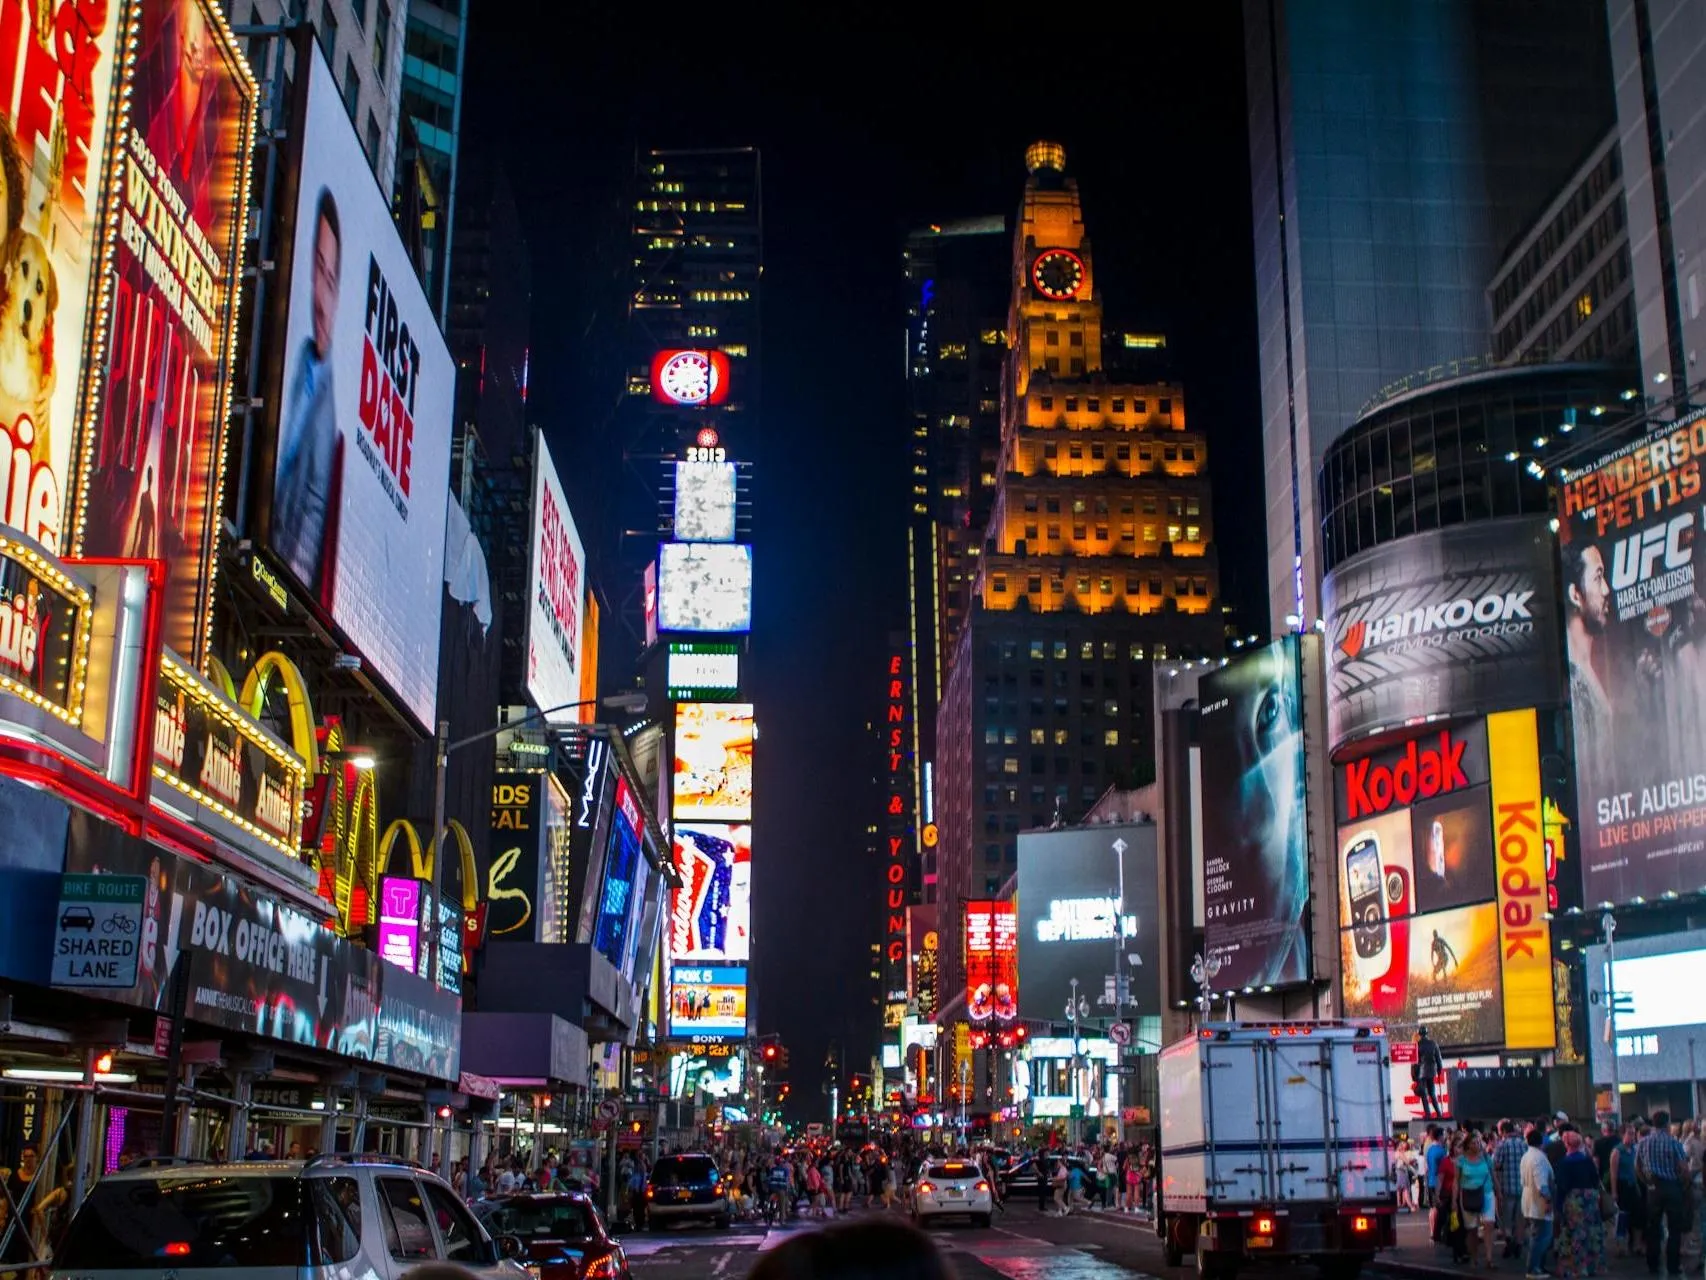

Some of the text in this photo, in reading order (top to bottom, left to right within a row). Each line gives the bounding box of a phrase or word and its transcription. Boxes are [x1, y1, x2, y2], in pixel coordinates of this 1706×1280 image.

[157, 165, 187, 224] TONY
[127, 154, 219, 323] WINNER!
[121, 207, 214, 360] BEST MUSICAL REVIVAL
[364, 250, 421, 419] FIRST
[359, 333, 414, 499] DATE
[686, 447, 726, 462] 2013
[1563, 464, 1593, 484] WORLD
[1593, 435, 1653, 470] LIGHTWEIGHT
[1563, 417, 1706, 517] HENDERSO
[1595, 461, 1702, 537] PETTIS
[1612, 512, 1695, 590] UFC
[1616, 564, 1696, 609] HARLEY-DAVIDSON
[1619, 594, 1655, 623] HOMETOWN
[1654, 584, 1695, 607] THROWDOWN
[1385, 620, 1534, 656] driving emotion
[888, 655, 904, 771] ERNST
[200, 732, 242, 806] Annie
[1344, 729, 1469, 819] Kodak
[255, 770, 291, 838] Annie
[888, 794, 904, 815] &
[1597, 791, 1636, 825] SAT.
[1599, 824, 1629, 848] LIVE
[1631, 821, 1651, 841] ON
[64, 883, 139, 897] BIKE ROUTE
[1206, 862, 1230, 875] BULLOCK
[1206, 880, 1233, 895] CLOONEY
[1497, 800, 1543, 962] Kodak
[888, 837, 905, 962] YOUNG
[1207, 897, 1255, 918] GRAVITY
[59, 938, 133, 957] SHARED
[191, 900, 233, 956] BOX
[235, 918, 284, 974] OFFICE
[286, 946, 316, 985] HERE
[69, 961, 119, 979] LANE
[674, 969, 702, 983] FOX
[1431, 995, 1442, 1005] FOR
[1442, 994, 1453, 1004] THE
[1453, 992, 1466, 1003] WAY
[1466, 991, 1479, 1001] YOU
[692, 1035, 724, 1043] SONY
[1457, 1068, 1543, 1079] MARQUIS
